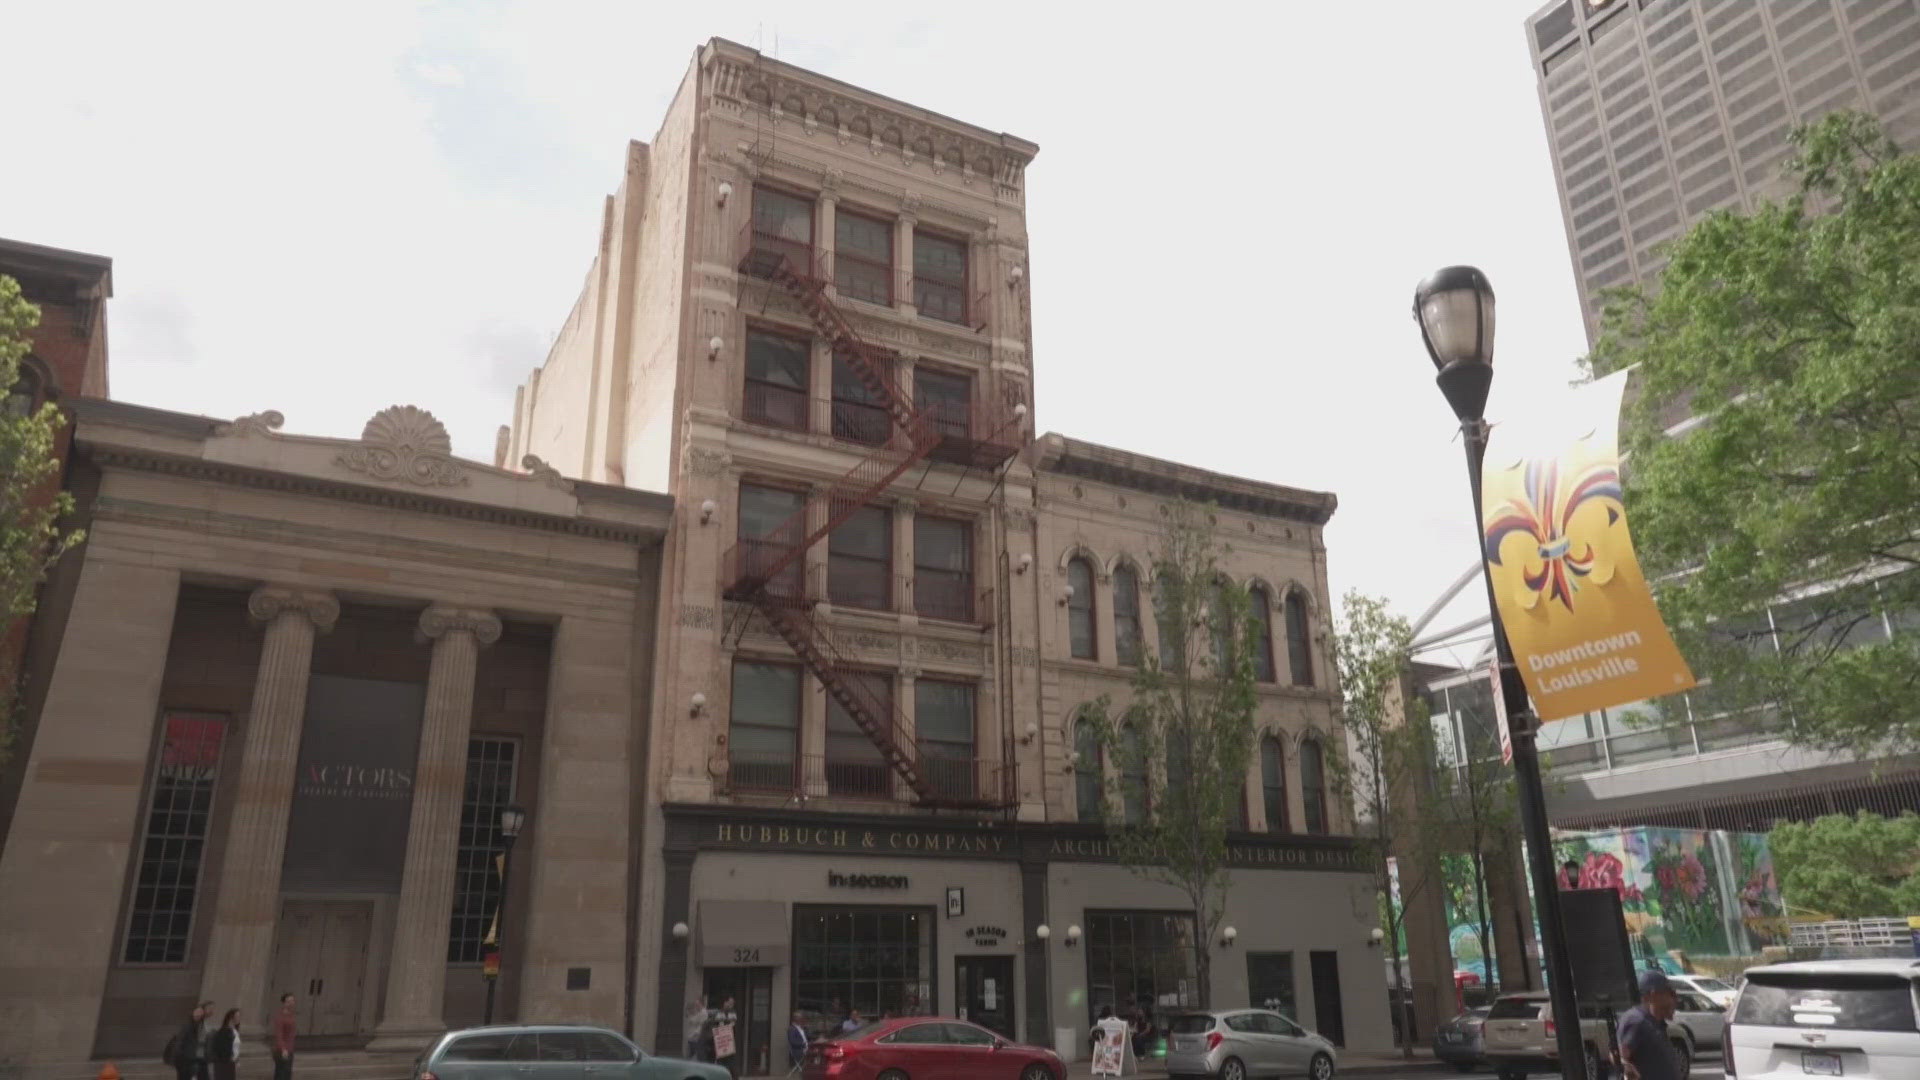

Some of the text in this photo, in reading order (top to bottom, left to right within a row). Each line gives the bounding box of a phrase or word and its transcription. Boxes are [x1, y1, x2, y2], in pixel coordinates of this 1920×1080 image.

[1528, 630, 1641, 672] Downtown
[1536, 656, 1639, 694] Louisville
[307, 765, 411, 788] ACTORS
[717, 824, 1003, 851] HUBBUCH & COMPANY
[1225, 847, 1307, 864] INTERIOR
[733, 949, 760, 963] 324
